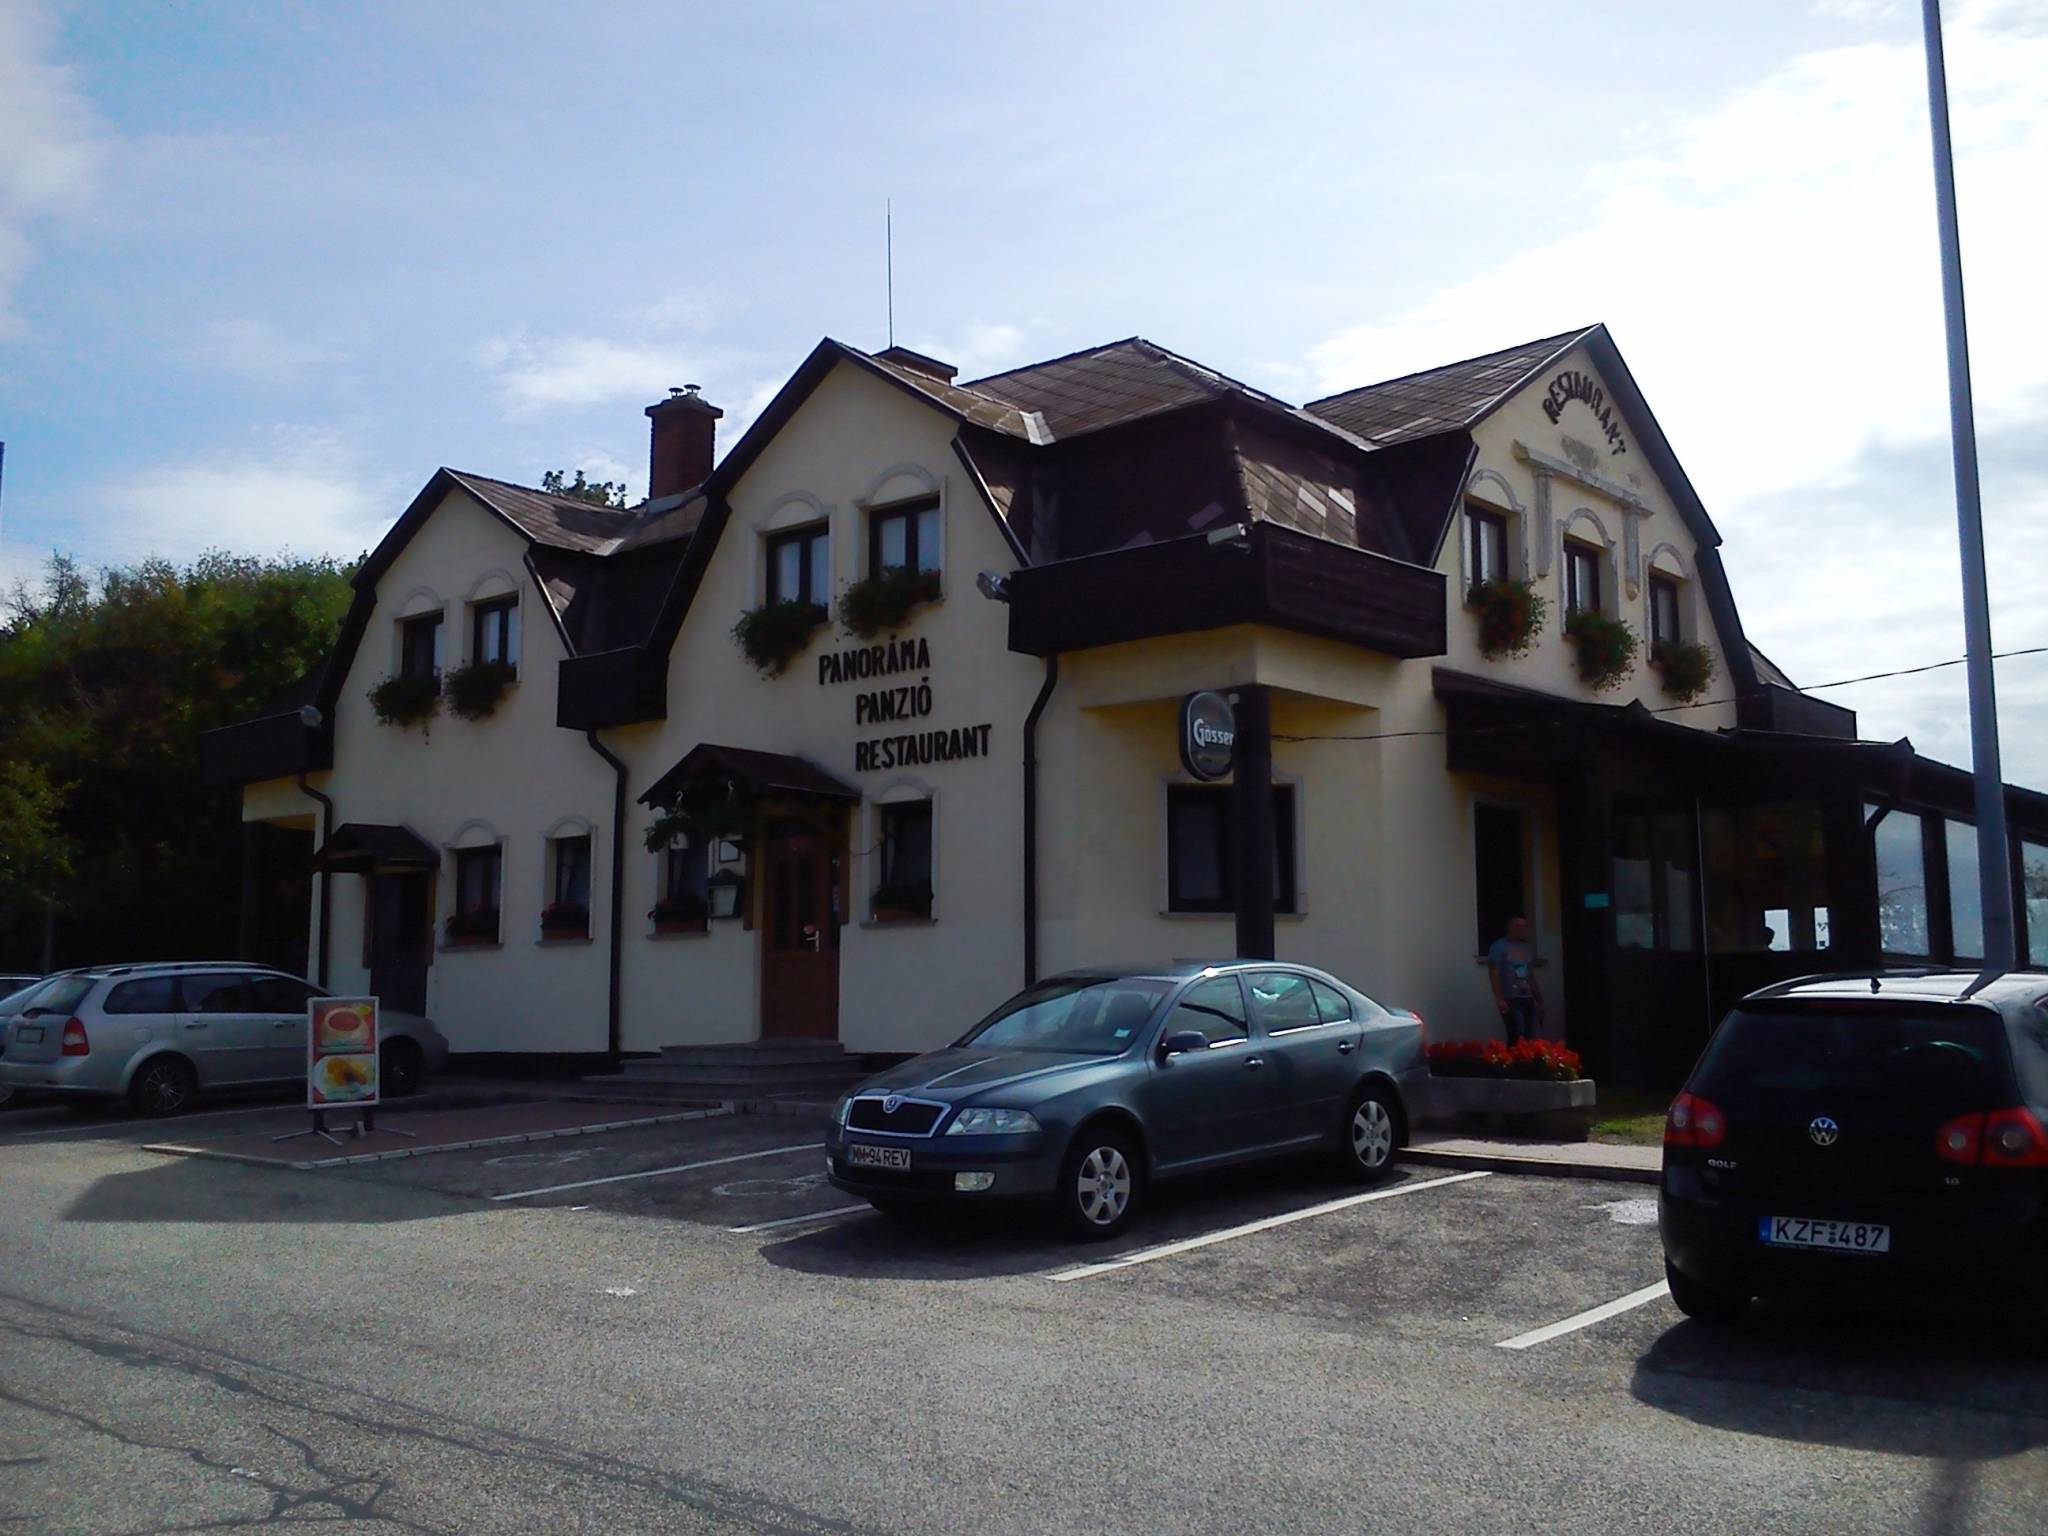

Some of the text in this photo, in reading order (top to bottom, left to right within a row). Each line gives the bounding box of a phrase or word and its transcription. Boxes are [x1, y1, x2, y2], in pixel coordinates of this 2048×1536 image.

[1542, 371, 1626, 456] RESTAURANT
[818, 634, 931, 686] PANORÁMA
[855, 676, 932, 725] PANZIÓ
[855, 723, 992, 772] RESTAURANT
